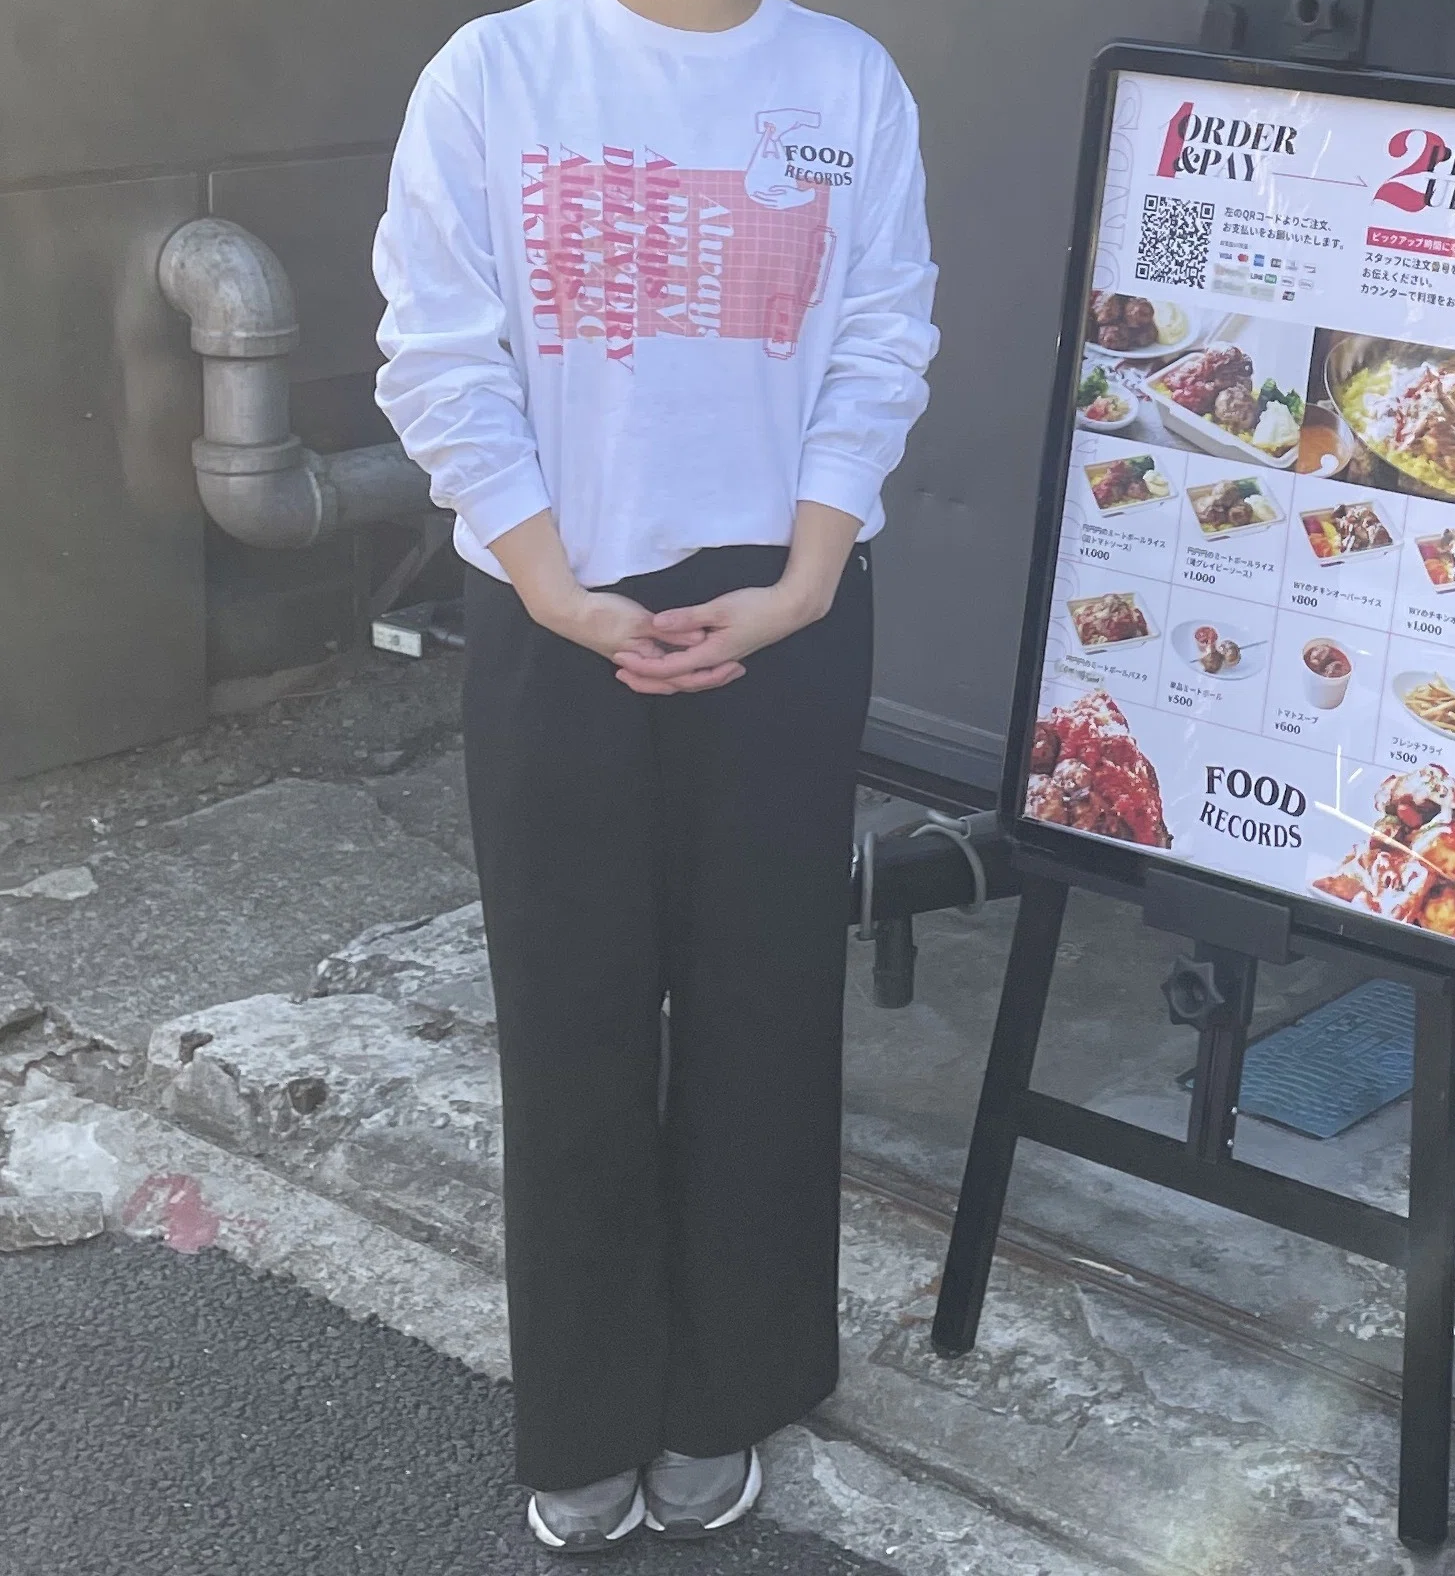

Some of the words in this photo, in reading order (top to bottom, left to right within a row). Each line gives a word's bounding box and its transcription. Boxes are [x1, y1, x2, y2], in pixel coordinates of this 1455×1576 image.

[784, 144, 855, 169] FOOD
[1177, 113, 1299, 156] ORDER
[784, 164, 853, 187] RECORDS
[1371, 128, 1446, 213] 2
[521, 142, 565, 365] TAKEOUT
[602, 142, 635, 375] DELIVERY
[1205, 765, 1307, 818] FOOD
[1198, 800, 1303, 849] RECORDS
